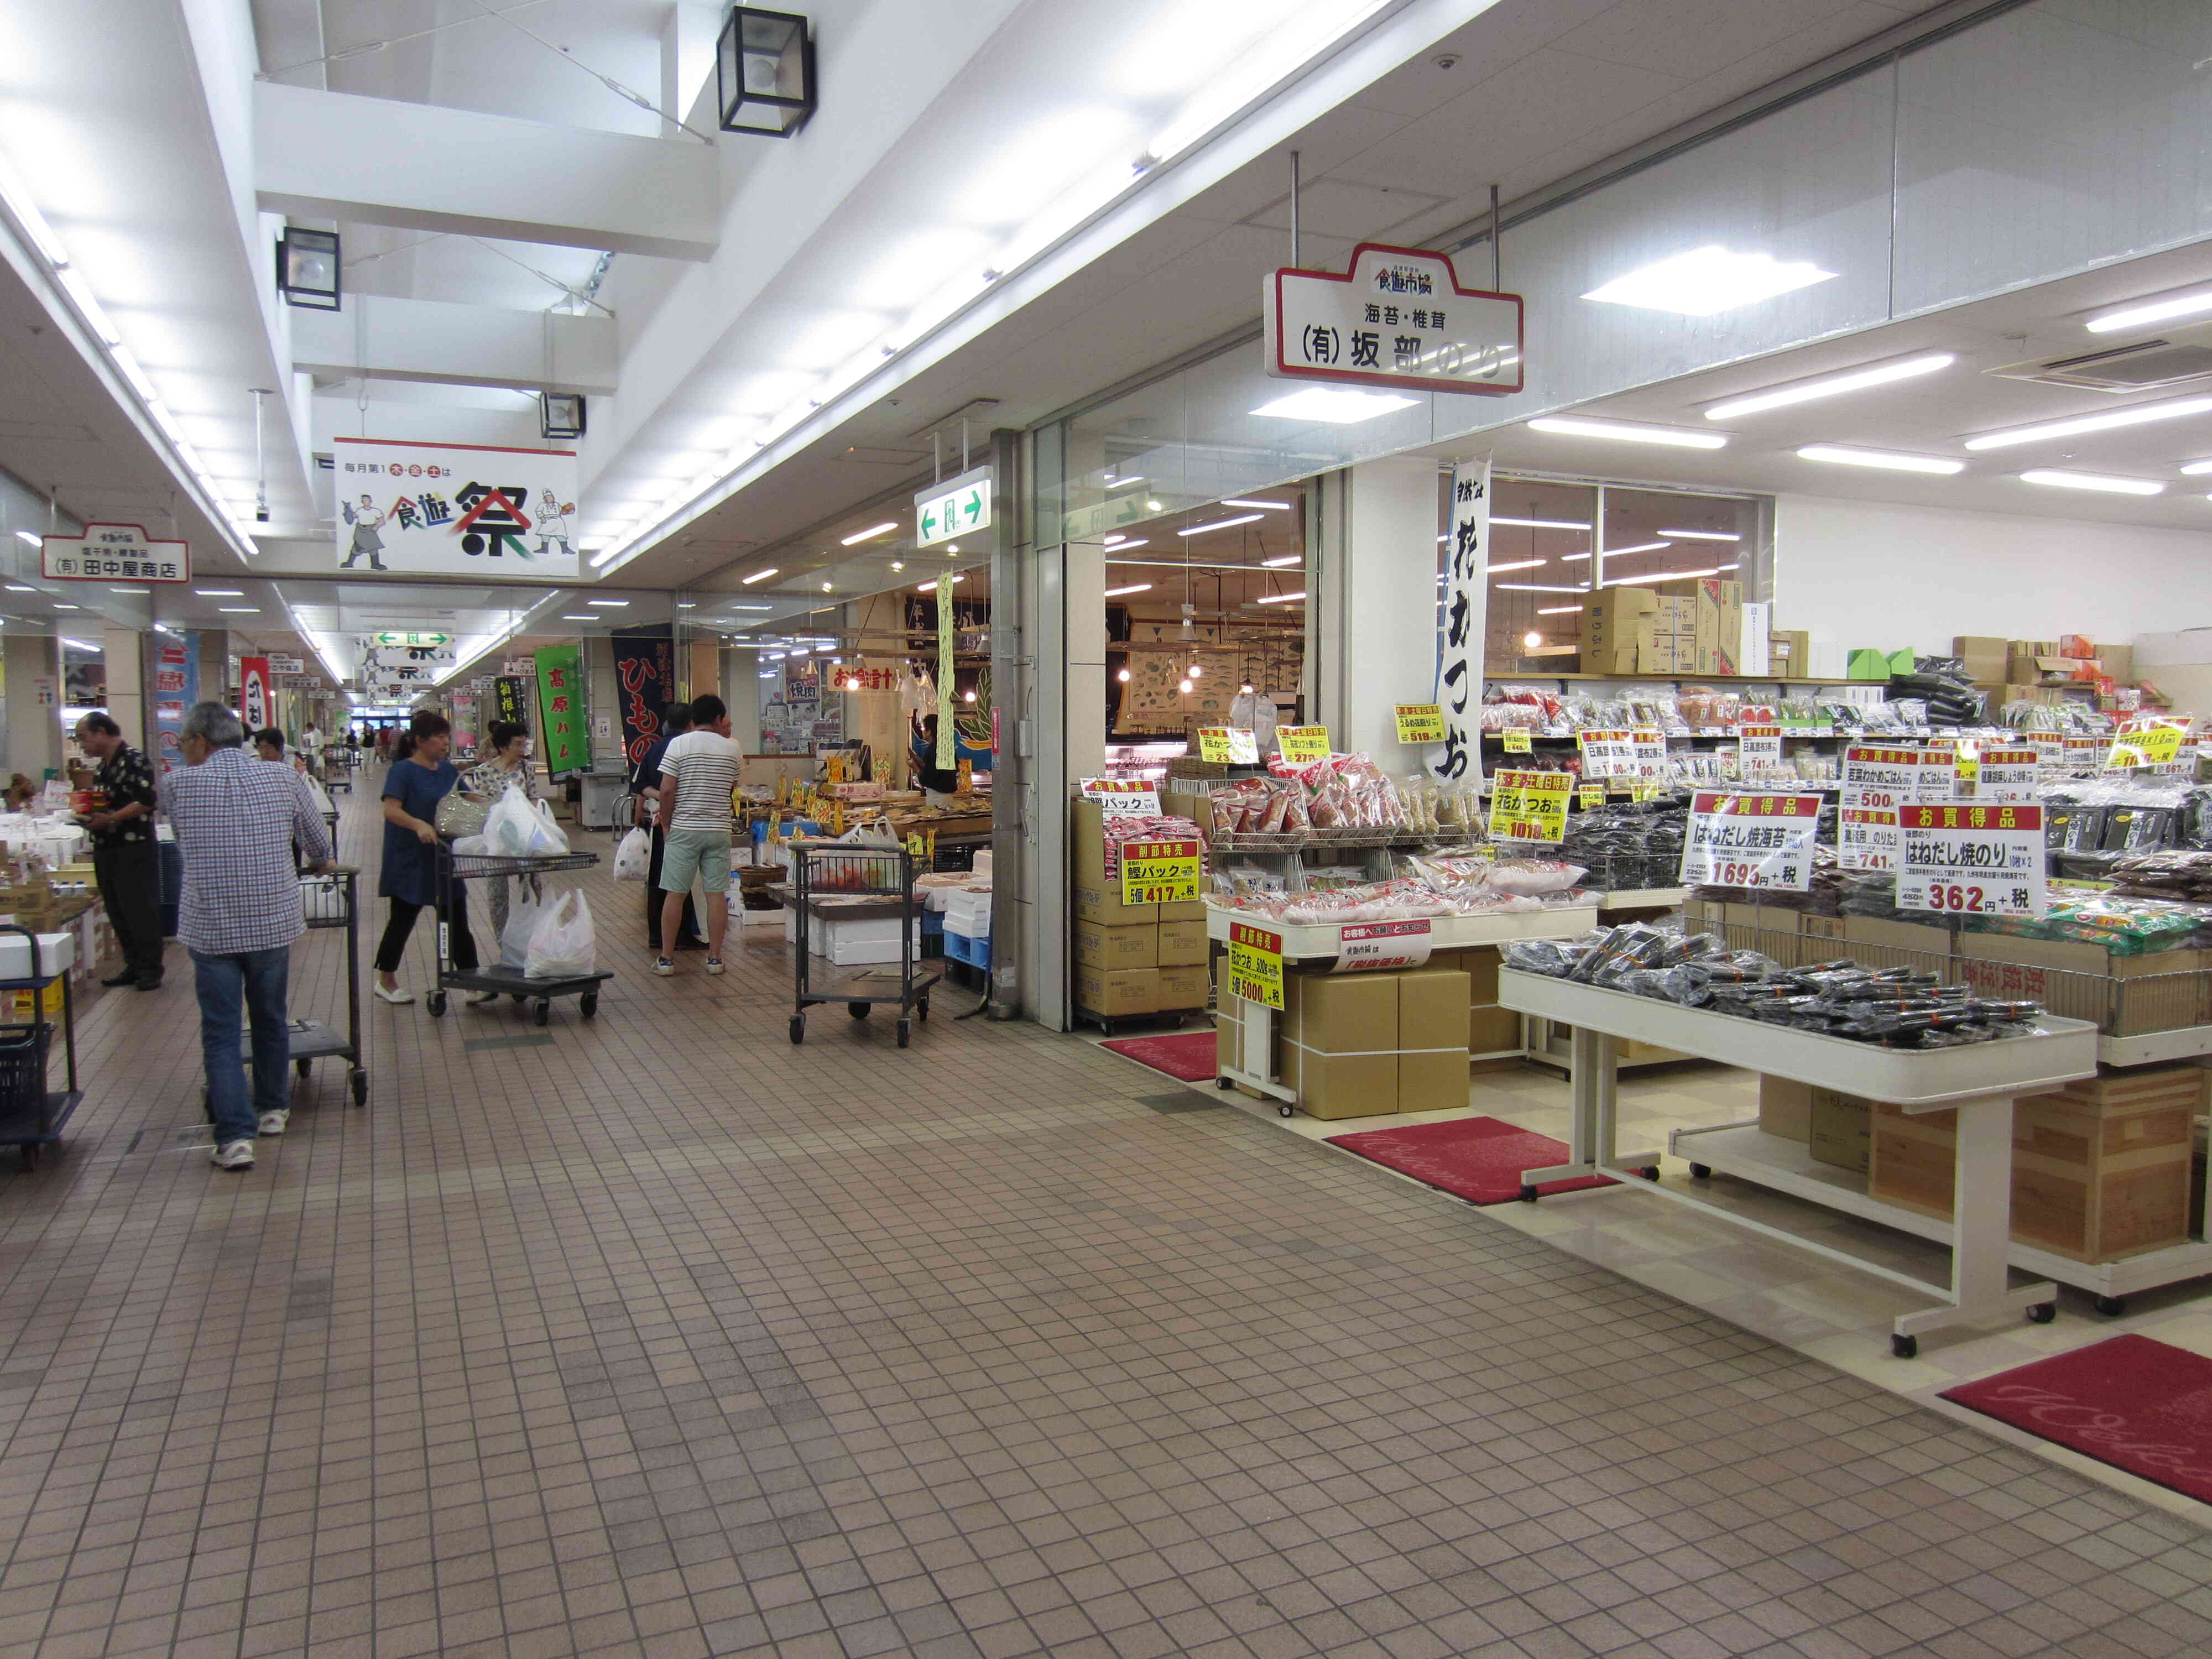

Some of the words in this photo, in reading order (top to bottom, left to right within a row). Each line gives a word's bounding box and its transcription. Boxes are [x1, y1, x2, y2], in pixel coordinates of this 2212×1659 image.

[1365, 303, 1446, 331] 海苔・椎茸
[56, 558, 176, 578] (有)田中屋商店
[1434, 515, 1479, 778] 花かつお
[789, 682, 817, 700] 焼肉
[547, 668, 570, 759] 高原ハム
[1858, 749, 1908, 763] お買得品
[1990, 753, 2029, 763] お買得品
[1496, 773, 1569, 790] 木・金・土曜日特売
[1497, 794, 1552, 813] 花かつお
[1713, 797, 1797, 815] お買得品
[1919, 806, 2016, 828] お買得品
[1694, 823, 1787, 848] はねだし焼海苔
[1139, 843, 1183, 858] 削節特売
[1905, 841, 2006, 868] はねだし焼のり
[1128, 864, 1179, 879] 鰹パック
[1130, 888, 1144, 903] 5個
[1239, 926, 1271, 950] 削節特売
[1343, 922, 1430, 938] お客様へお願いとお知らせ
[1231, 950, 1251, 970] 花かつお
[1232, 975, 1240, 995] 5個
